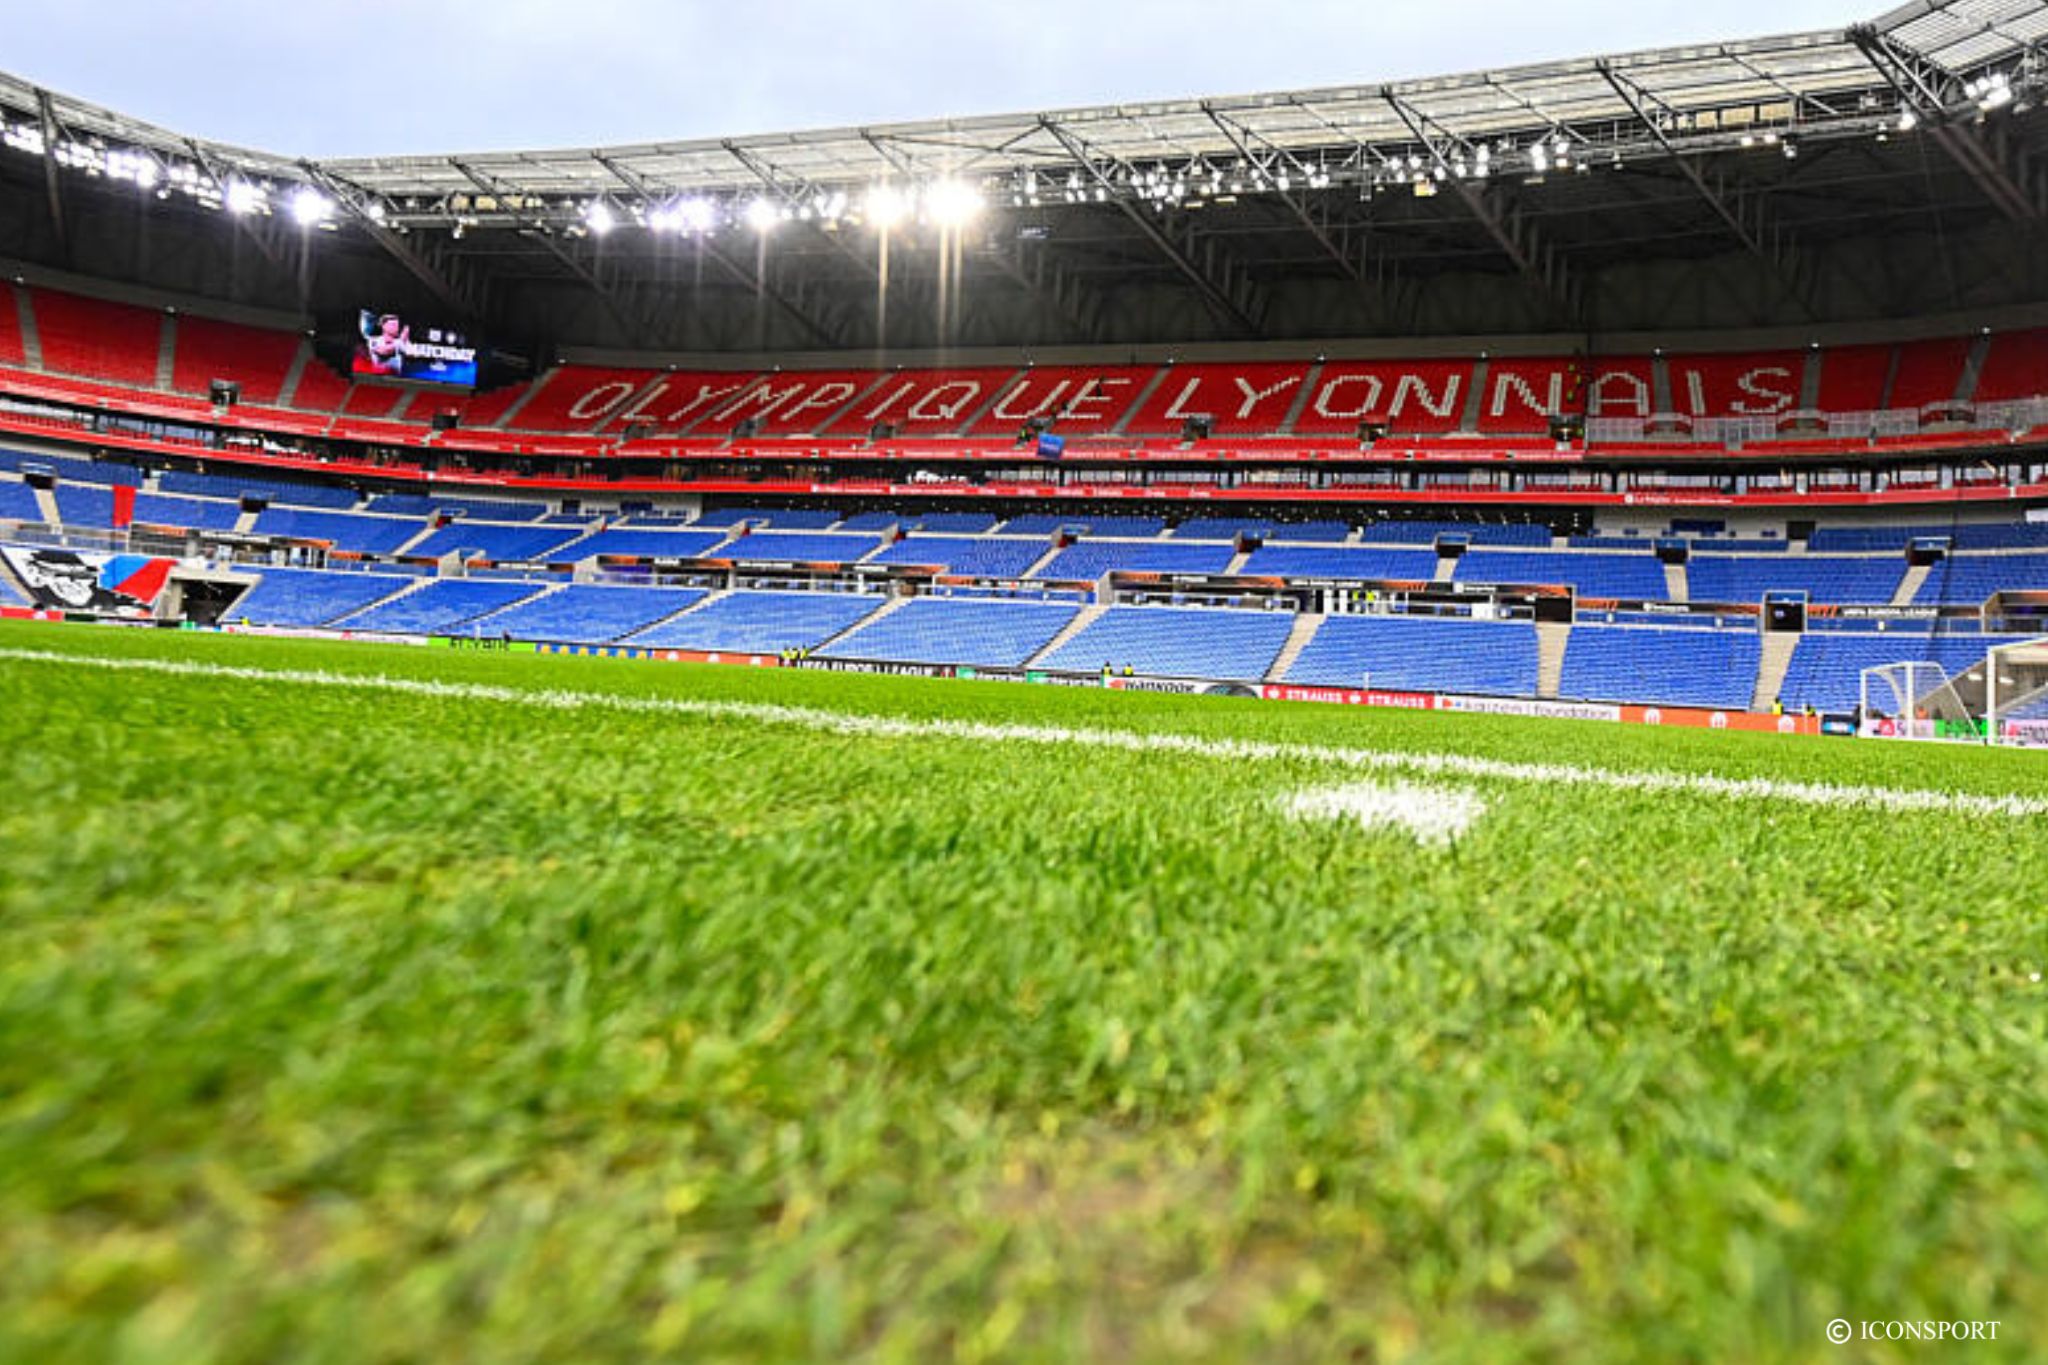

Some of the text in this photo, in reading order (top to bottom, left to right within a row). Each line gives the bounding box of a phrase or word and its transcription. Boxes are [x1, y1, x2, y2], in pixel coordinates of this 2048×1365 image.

[568, 366, 1793, 422] OLYMPIQUE LYONNAIS
[1286, 689, 1343, 704] STRAUSS
[1368, 693, 1426, 708] STRAUSS
